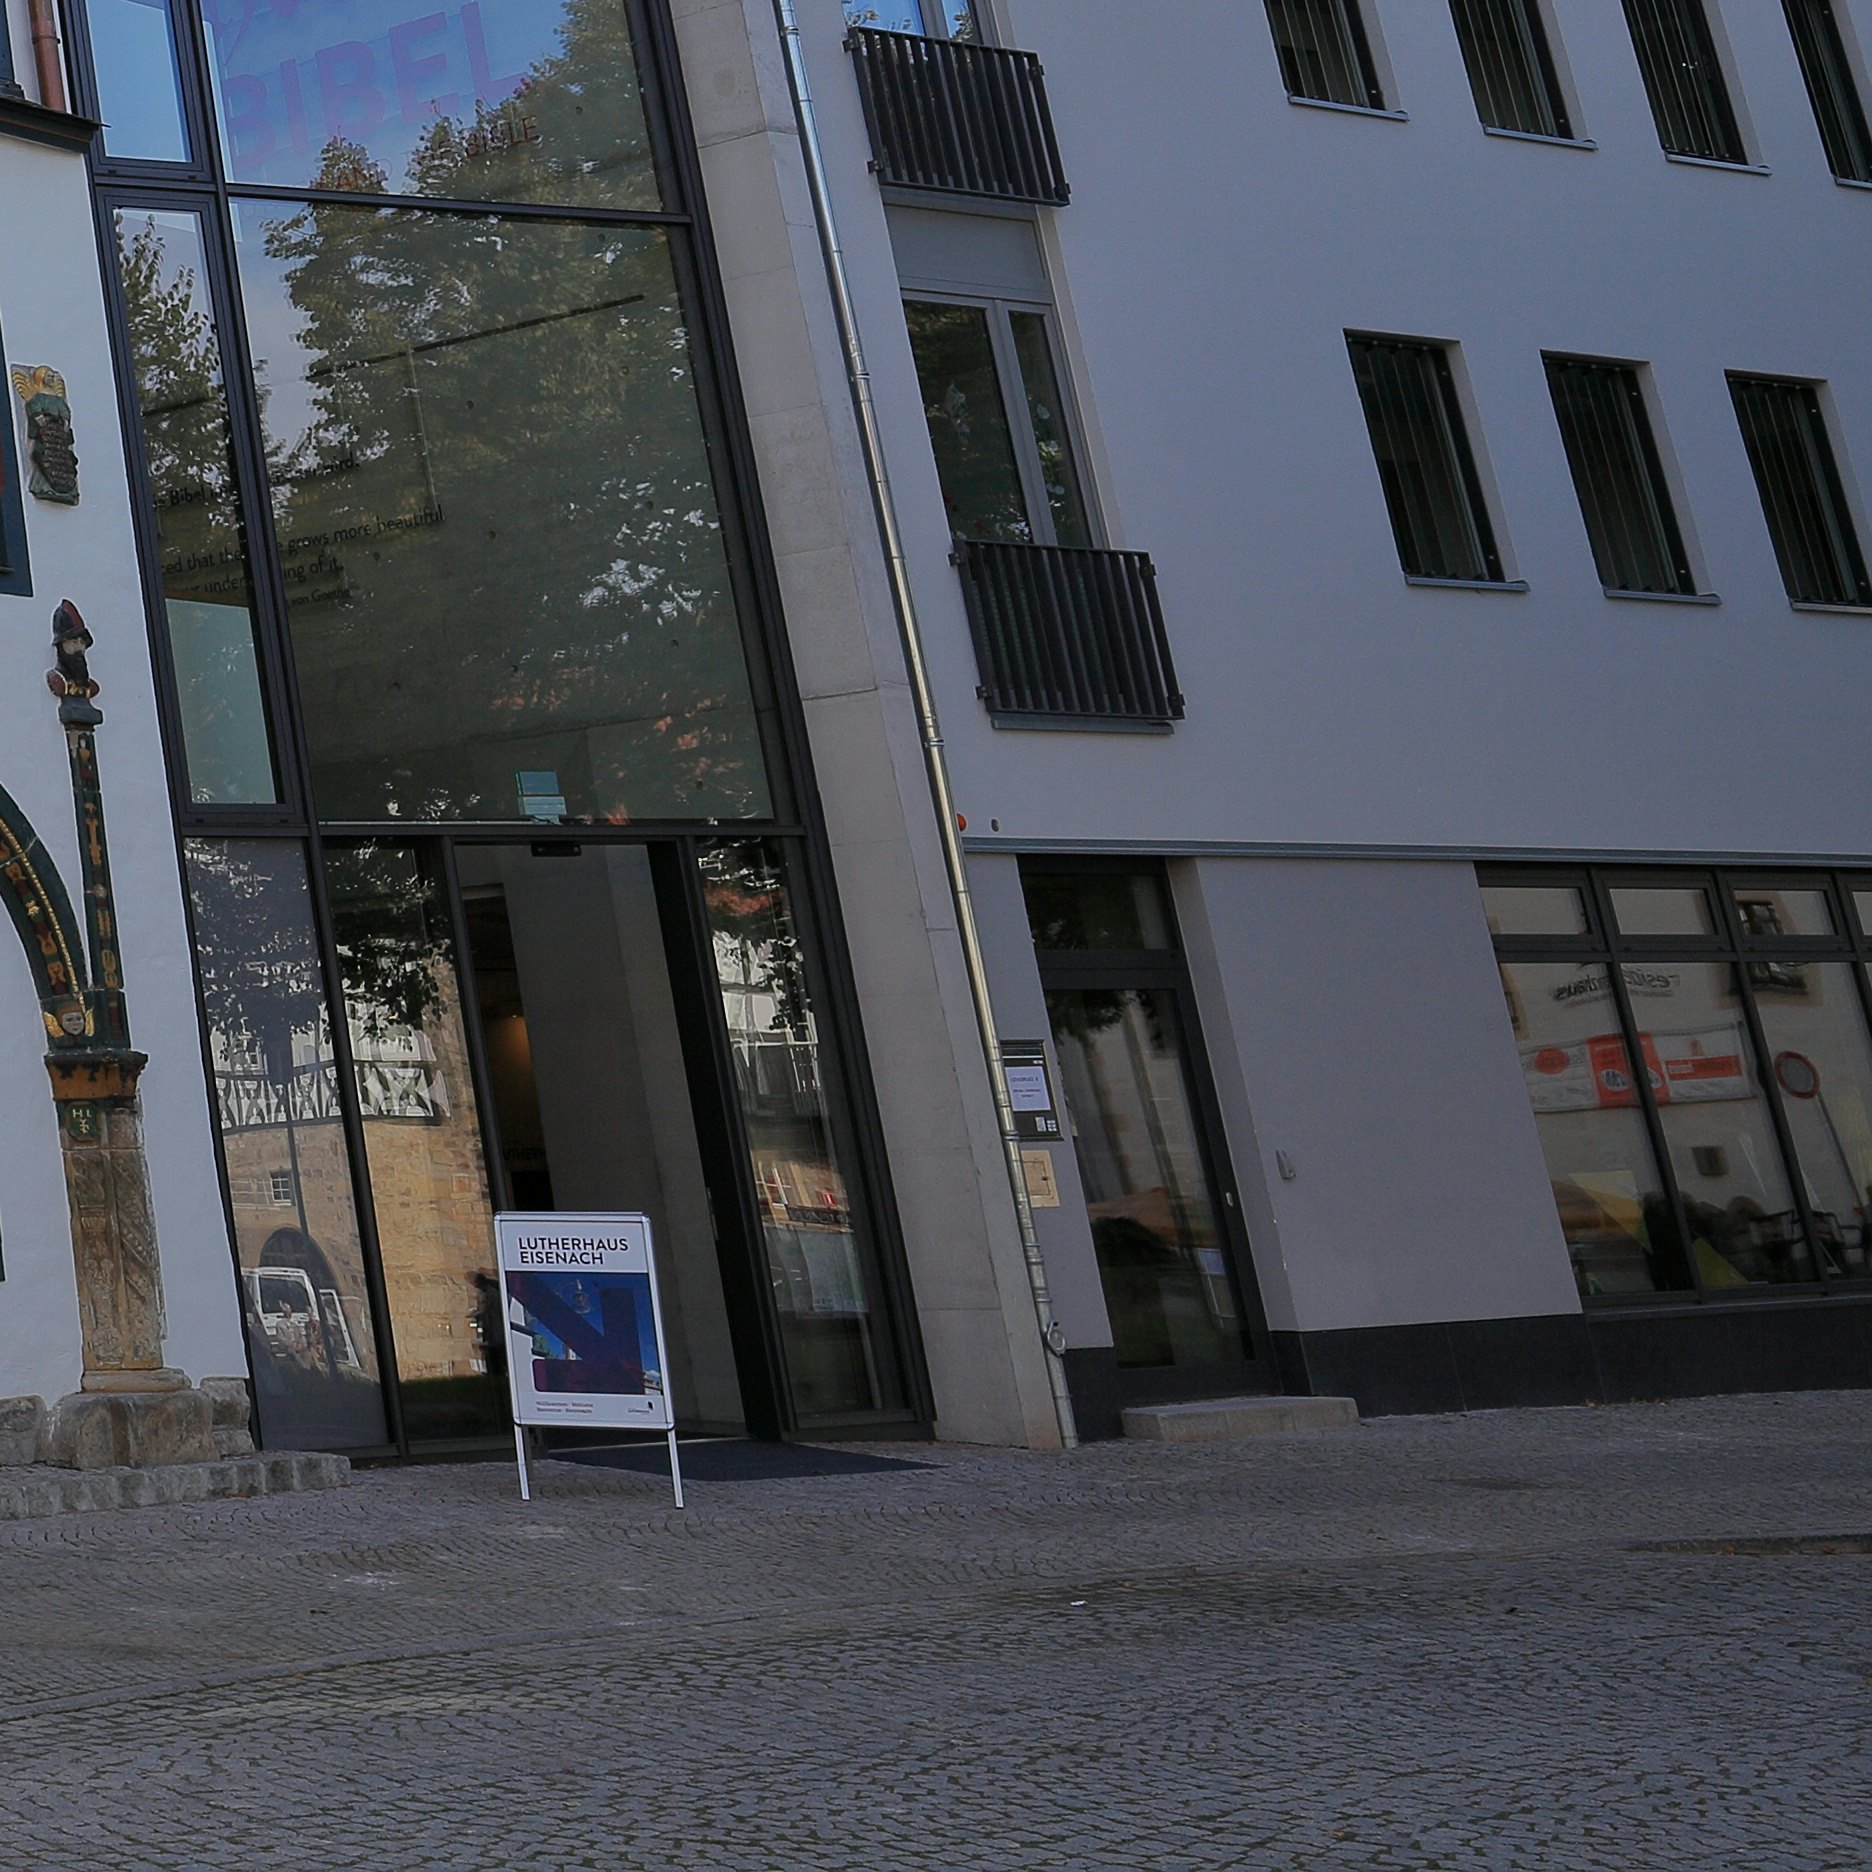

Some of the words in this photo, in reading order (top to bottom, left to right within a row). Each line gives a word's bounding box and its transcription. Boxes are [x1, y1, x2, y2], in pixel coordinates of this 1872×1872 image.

[223, 1, 529, 175] BIBEL
[169, 485, 205, 507] Bibel
[187, 551, 214, 571] that
[288, 533, 329, 556] grows
[334, 524, 371, 543] more
[376, 503, 445, 533] beautiful
[308, 555, 324, 574] of
[518, 1236, 629, 1252] LUTHERHAUS
[520, 1251, 604, 1266] EISENACH
